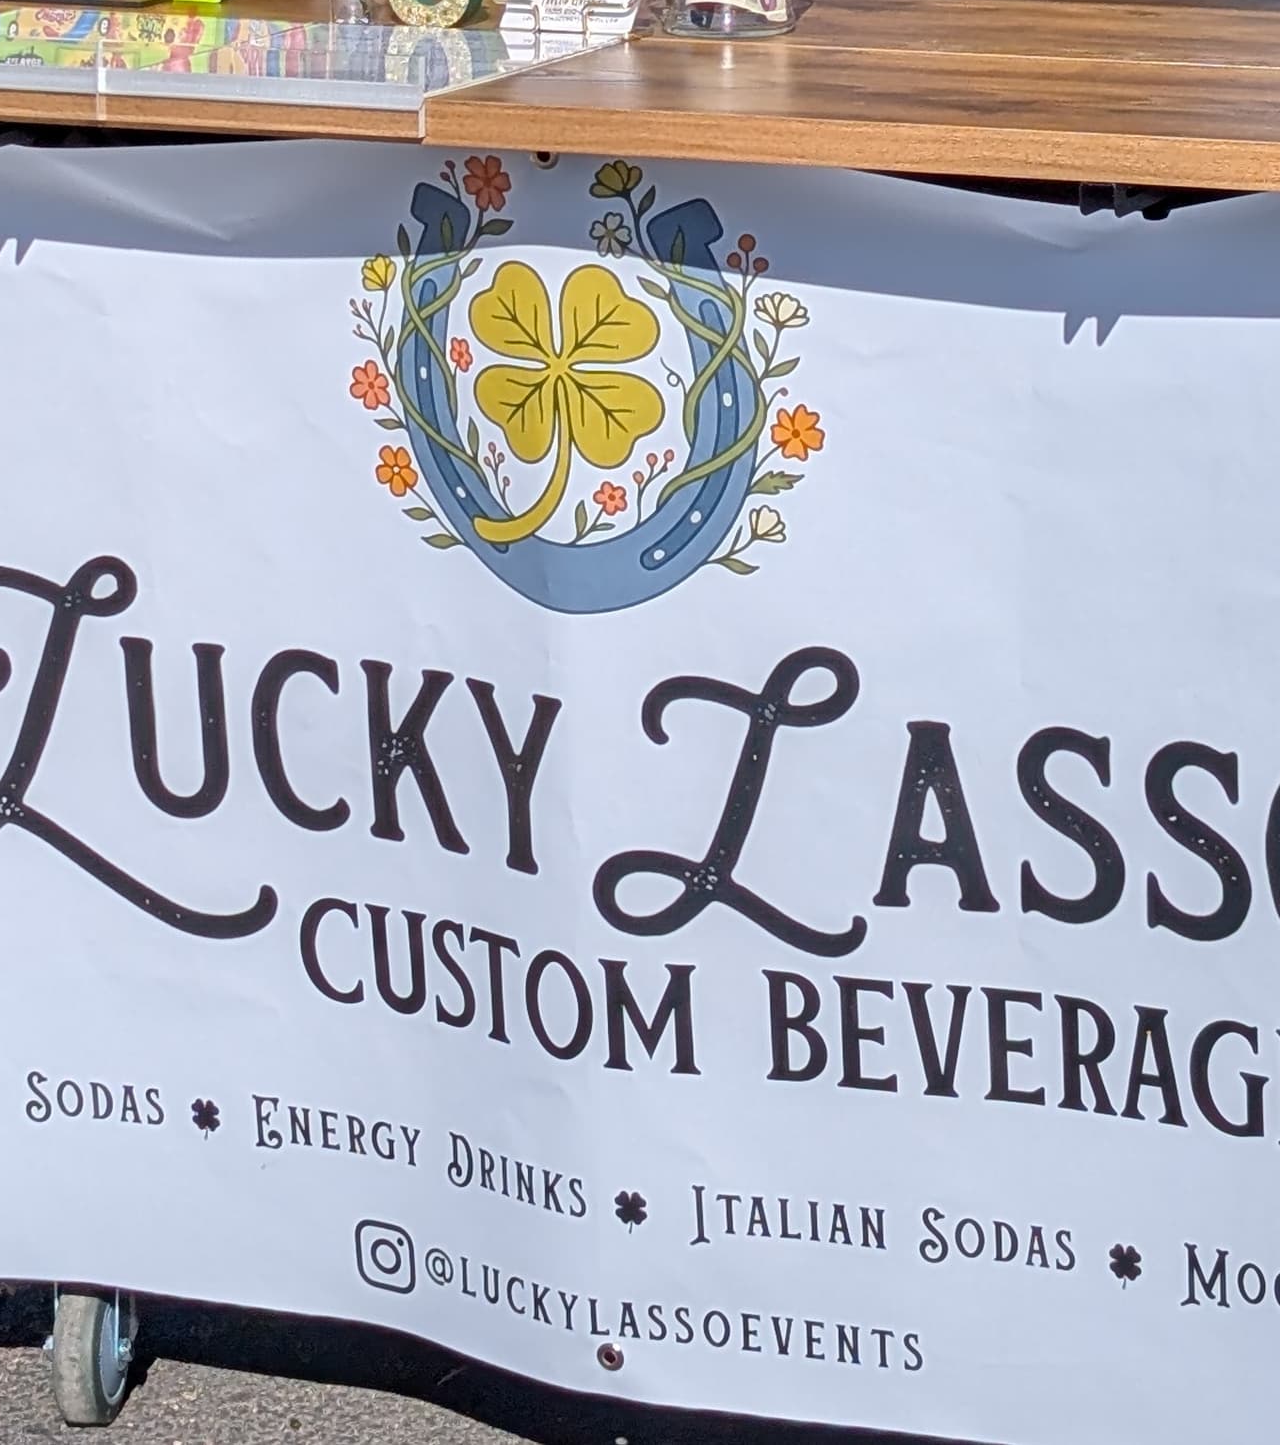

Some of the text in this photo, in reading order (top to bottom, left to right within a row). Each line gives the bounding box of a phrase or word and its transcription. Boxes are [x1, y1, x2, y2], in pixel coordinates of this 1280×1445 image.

[300, 897, 702, 1076] CUSTOM
[25, 1070, 166, 1126] SODAS
[252, 1093, 421, 1167] ENERGY
[447, 1130, 588, 1219] DRINKS
[688, 1184, 888, 1250] ITALIAN
[918, 1207, 1077, 1273] SODAS
[424, 1247, 925, 1372] @LUCKYLASSOEVENTS
